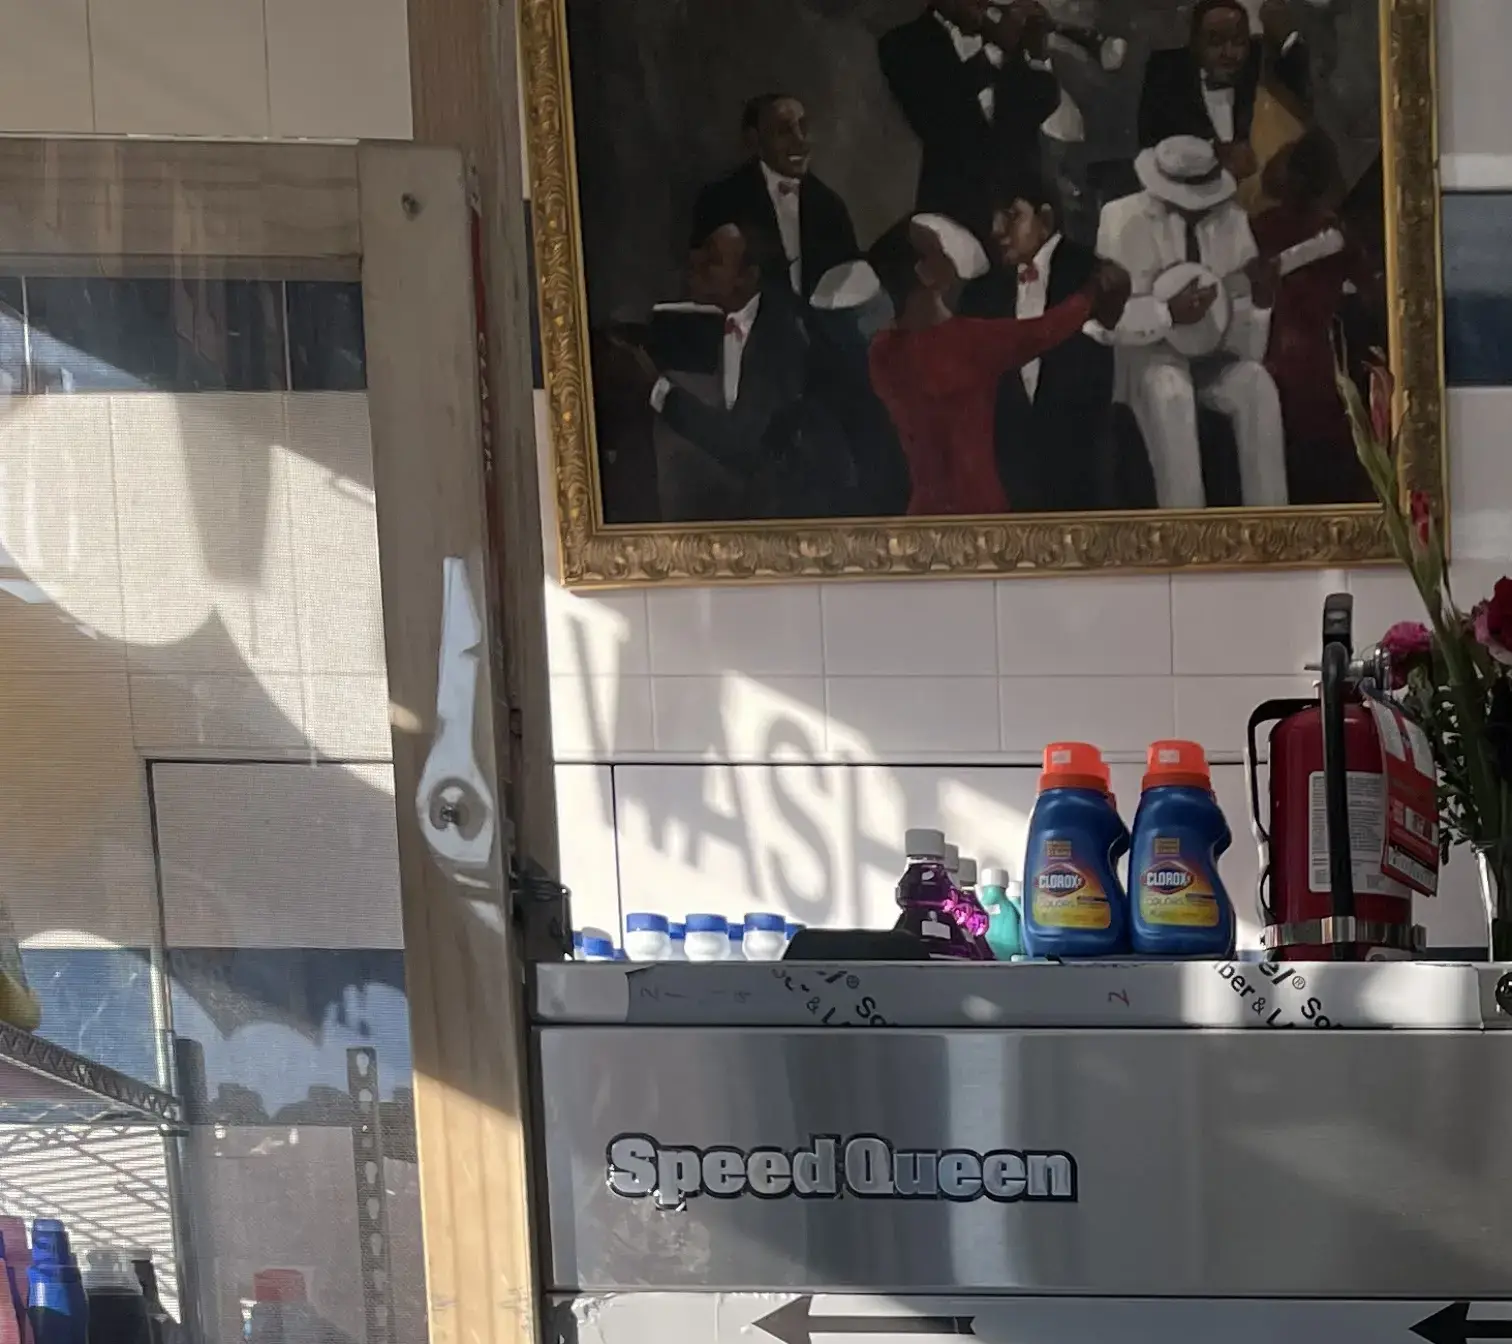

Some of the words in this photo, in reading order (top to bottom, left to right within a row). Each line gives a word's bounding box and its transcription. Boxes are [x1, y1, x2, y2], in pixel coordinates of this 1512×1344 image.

[1038, 874, 1078, 889] CLOROX
[1146, 872, 1187, 887] CLOROX
[605, 1133, 842, 1210] Speed
[841, 1133, 1078, 1202] Queen
